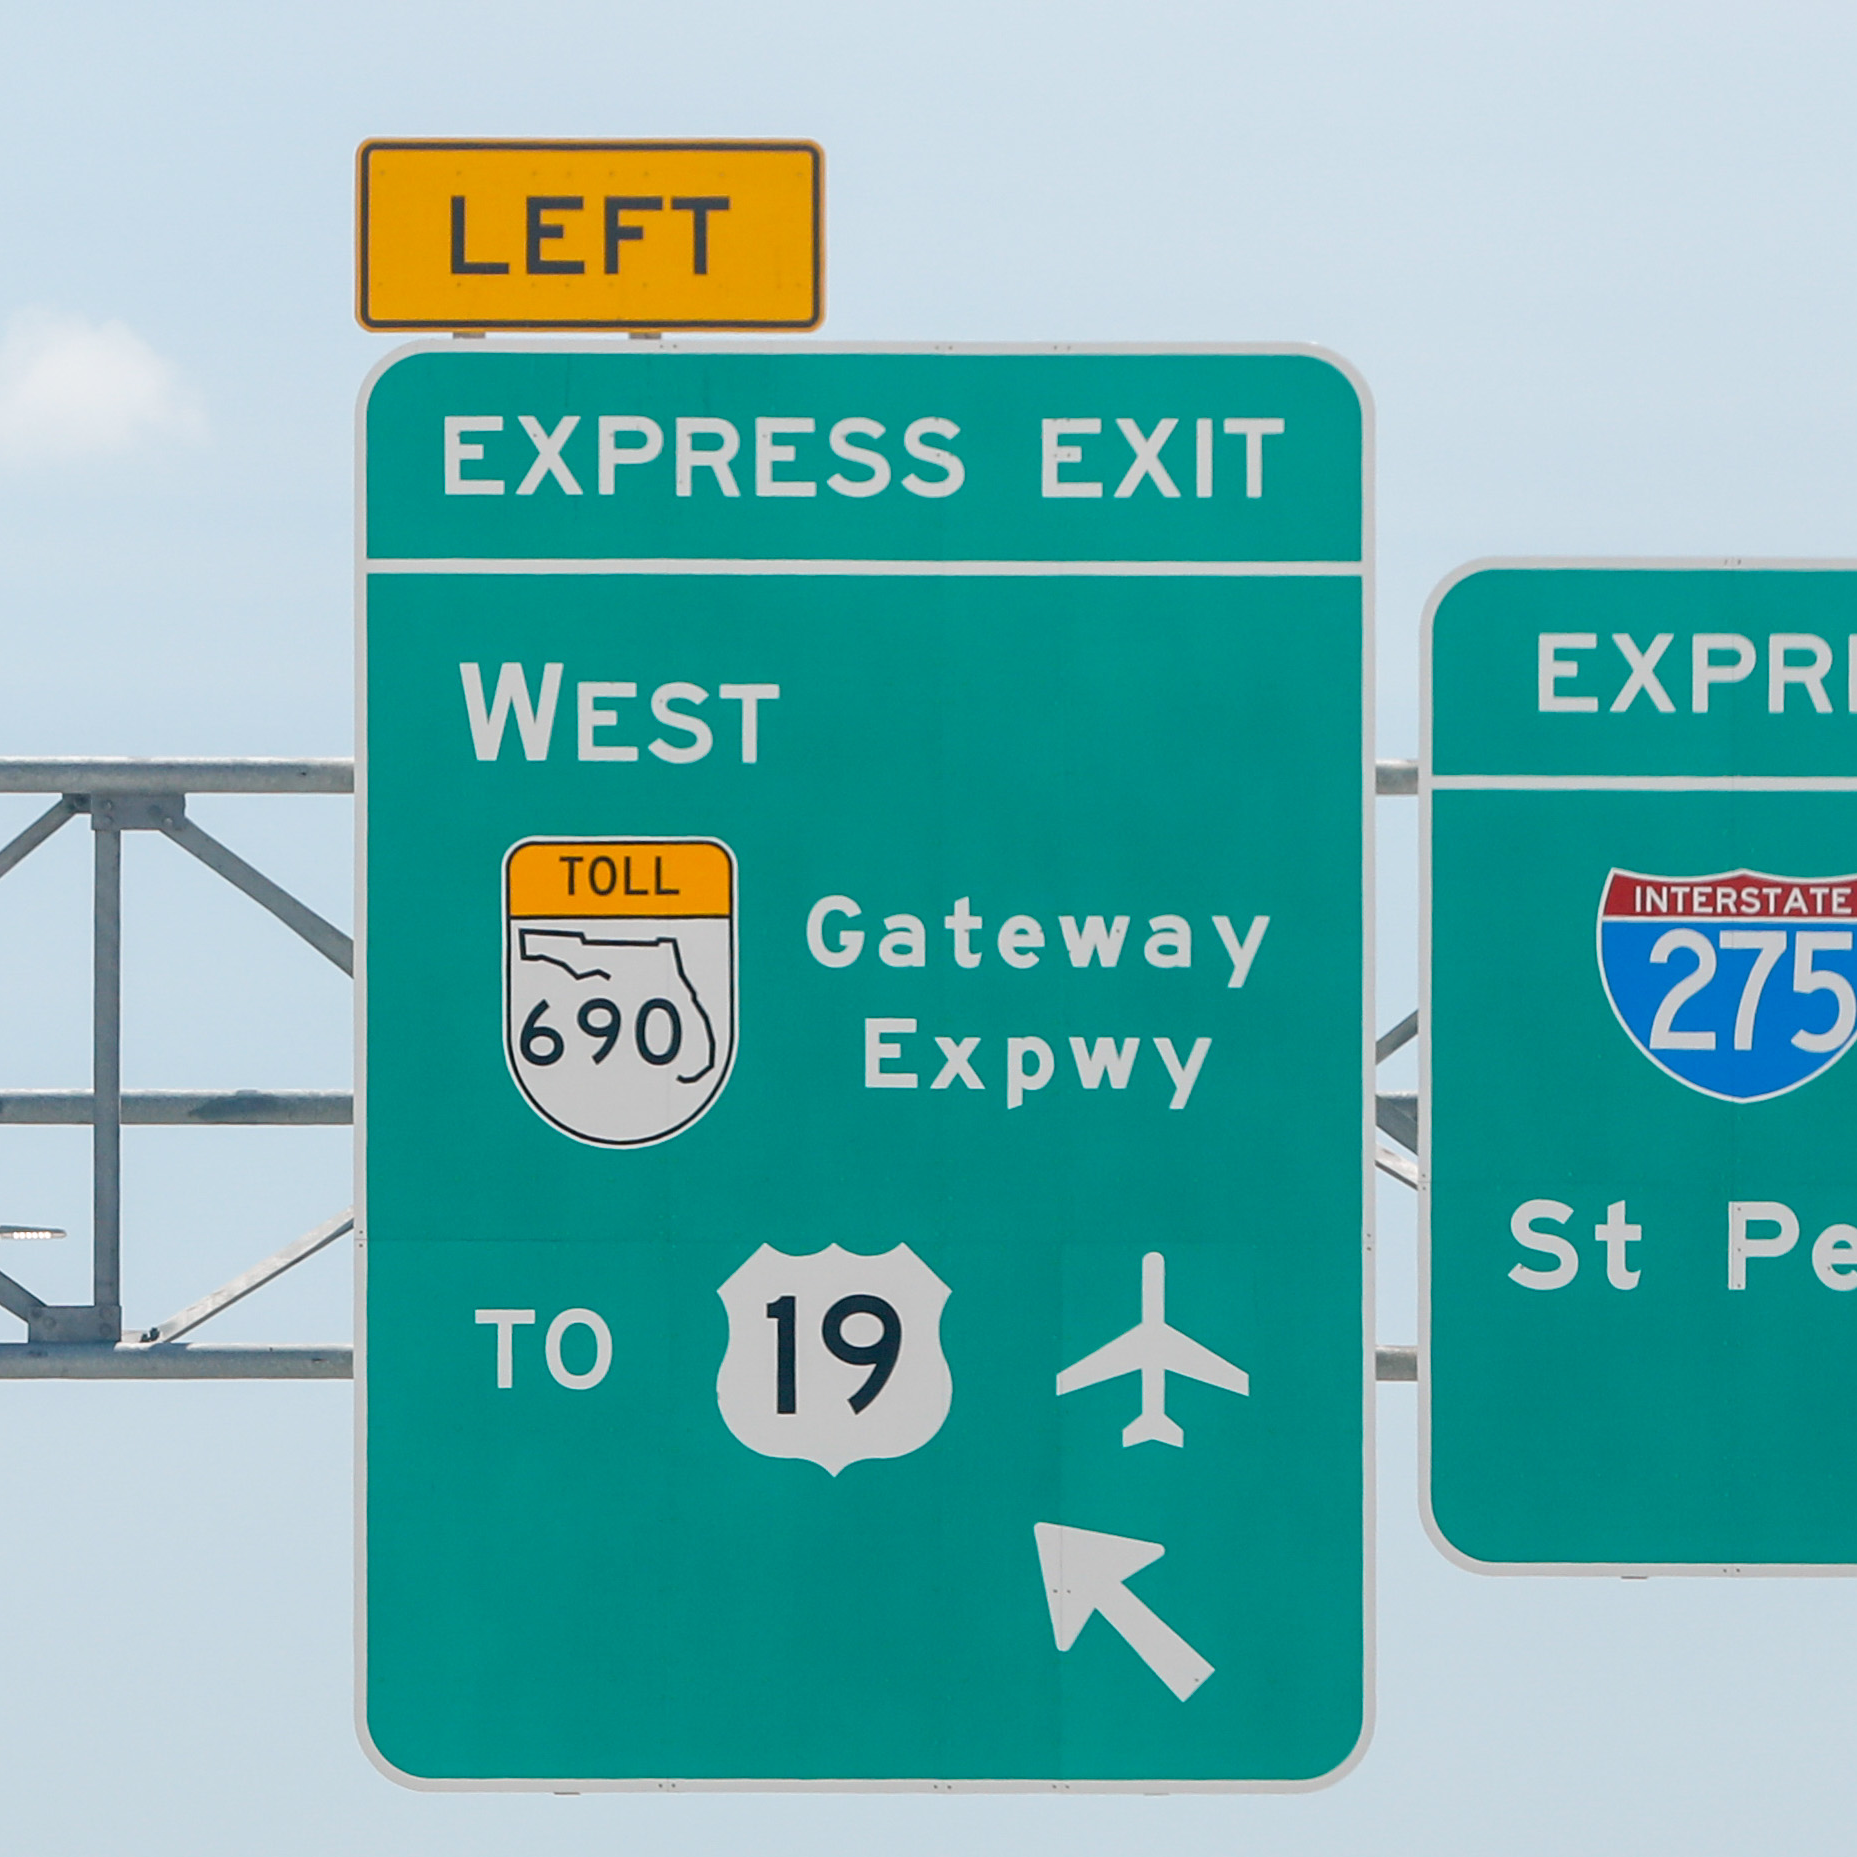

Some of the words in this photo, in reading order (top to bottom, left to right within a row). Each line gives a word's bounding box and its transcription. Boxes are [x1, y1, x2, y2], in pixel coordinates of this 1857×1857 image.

[450, 195, 731, 276] LEFT
[443, 414, 967, 499] EXPRESS
[1040, 417, 1286, 499] EXIT
[458, 661, 781, 765] WEST
[558, 855, 681, 897] TOLL
[1633, 885, 1854, 915] INTERSTATE
[805, 895, 1271, 989] Gateway
[519, 997, 683, 1067] 690
[1648, 927, 1857, 1054] 275
[863, 1017, 1213, 1111] Expwy
[1507, 1199, 1644, 1292] St
[473, 1307, 615, 1391] TO
[765, 1293, 903, 1416] 19
